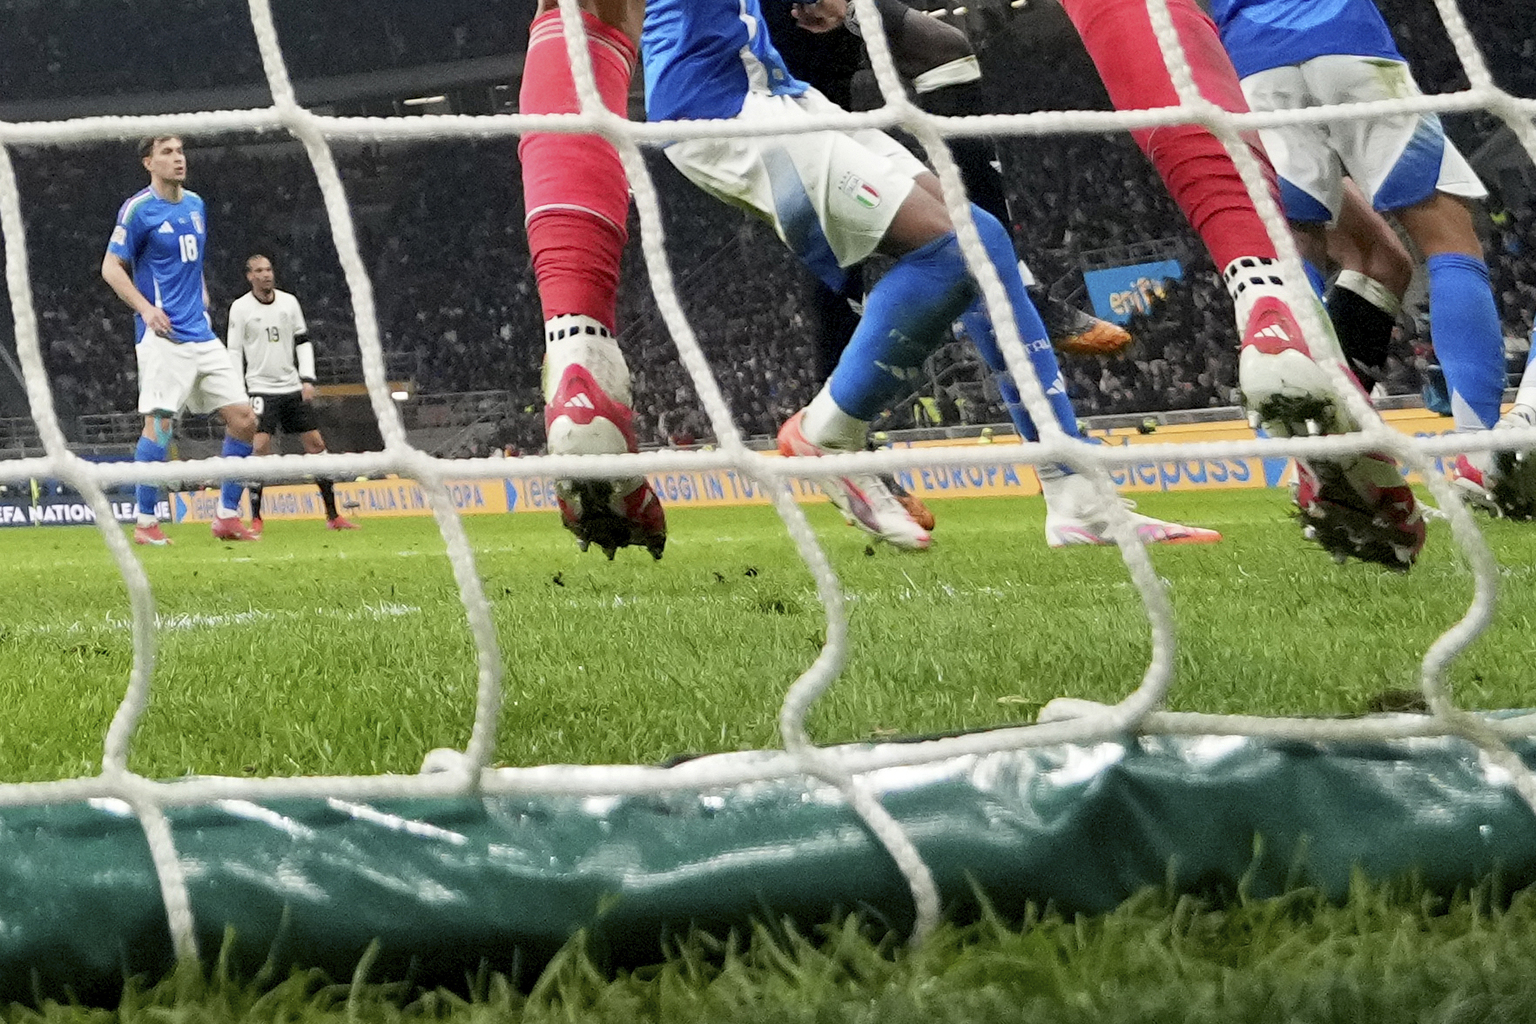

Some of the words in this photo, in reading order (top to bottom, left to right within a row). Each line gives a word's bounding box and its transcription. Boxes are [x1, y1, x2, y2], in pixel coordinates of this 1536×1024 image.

[178, 234, 198, 264] 18
[265, 326, 280, 342] 19
[922, 464, 1021, 490] EUROPA
[28, 503, 98, 523] NATION
